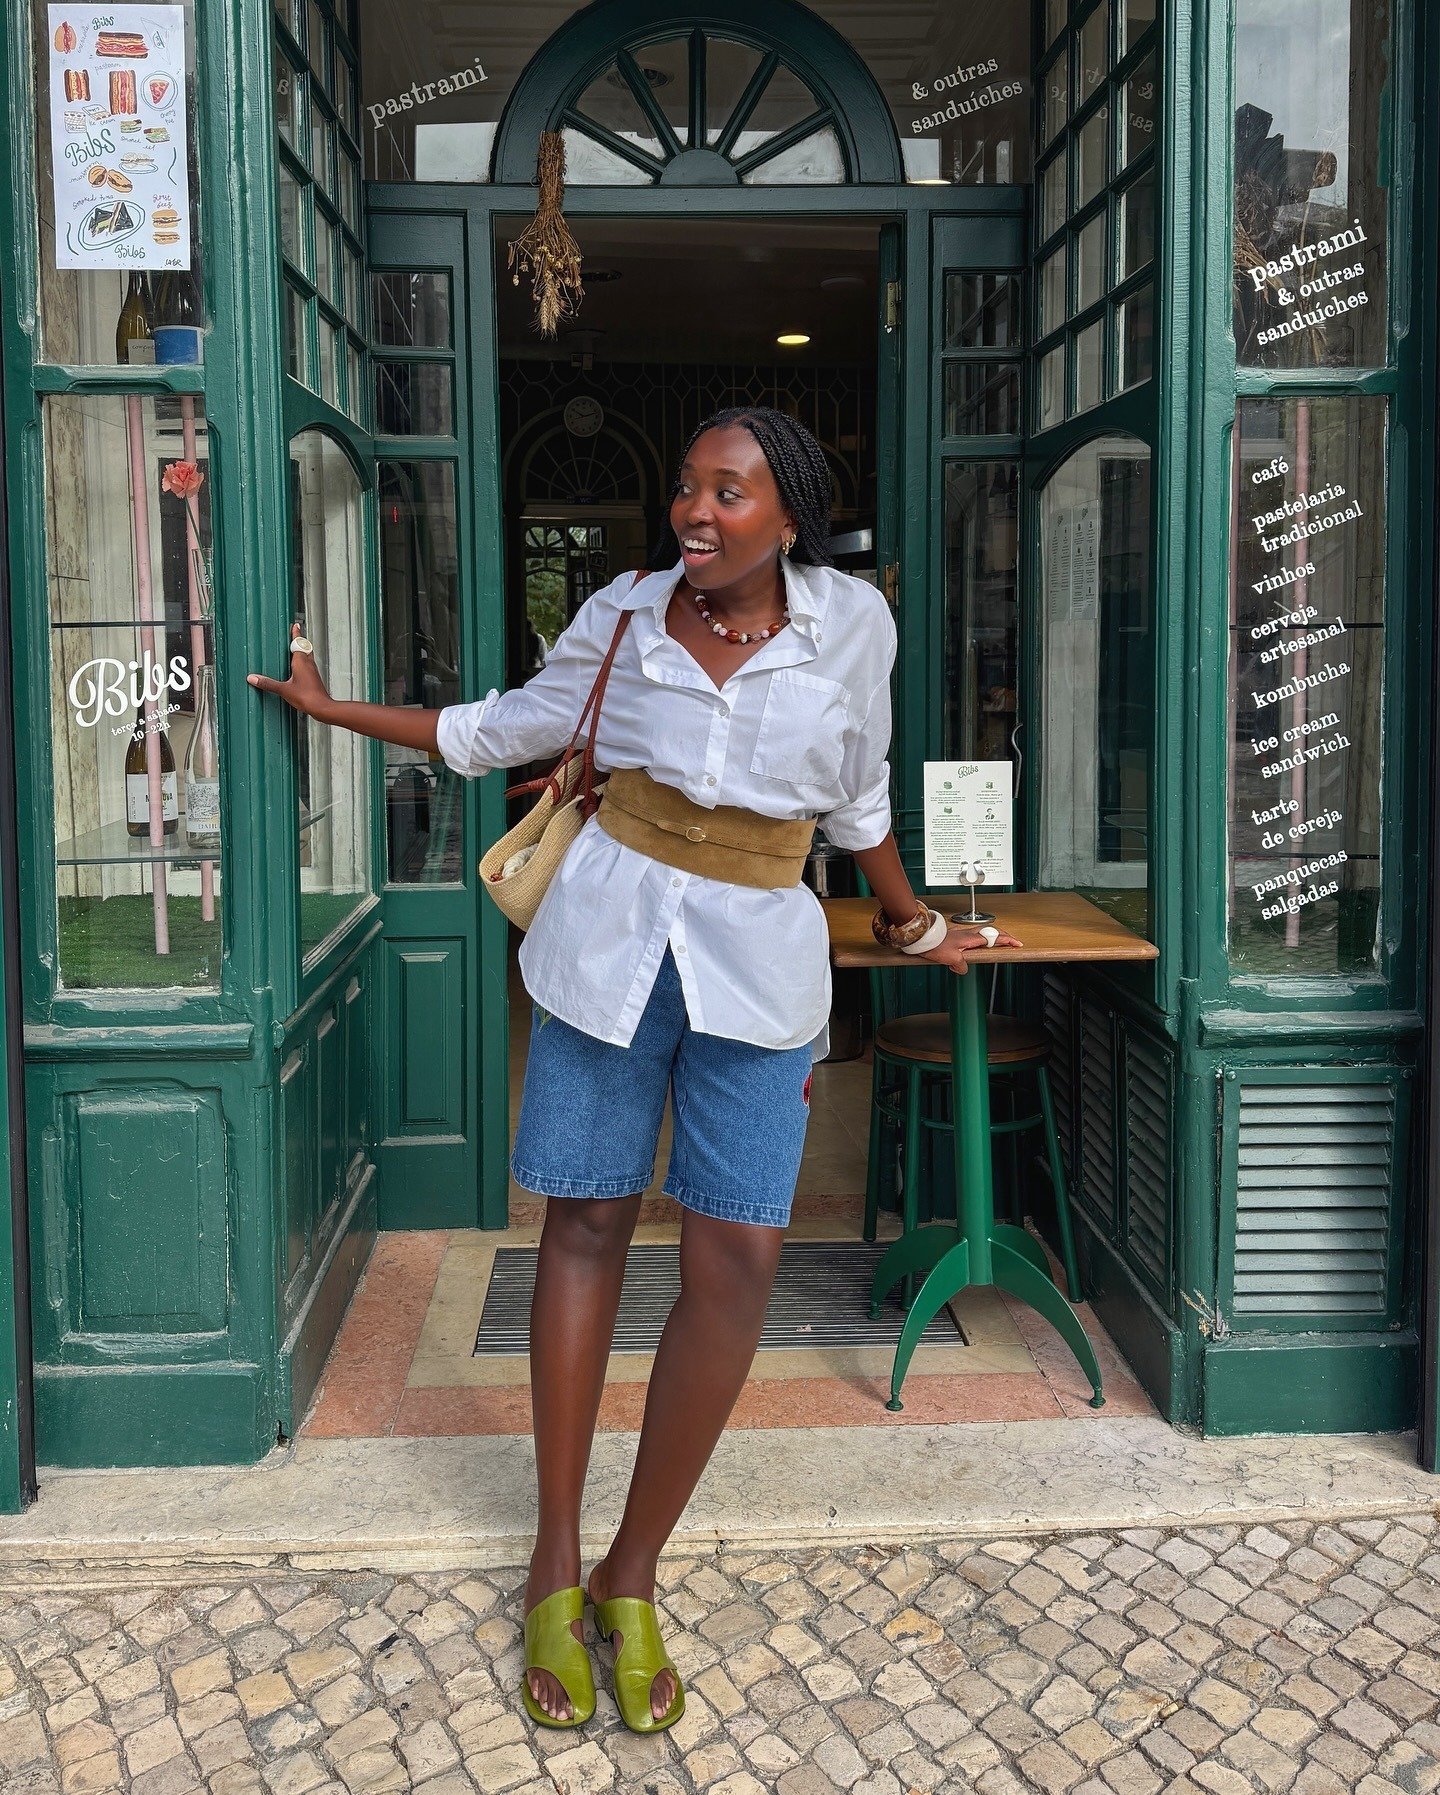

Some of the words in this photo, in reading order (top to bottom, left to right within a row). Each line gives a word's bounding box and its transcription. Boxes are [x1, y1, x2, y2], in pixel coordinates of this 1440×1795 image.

[92, 16, 115, 31] Bibs
[367, 56, 489, 128] pastrami
[912, 81, 929, 101] &
[933, 58, 997, 92] outras
[911, 80, 1024, 134] sanduíches
[65, 128, 116, 167] Bibs
[114, 243, 146, 259] Bibs
[1247, 218, 1368, 292] pastrami
[1277, 288, 1296, 307] &
[1299, 260, 1365, 298] outras
[1256, 288, 1369, 346] sanduíches
[1251, 456, 1289, 484] café
[1251, 482, 1346, 534] pastelaria
[1260, 500, 1364, 553] tradicional
[1251, 561, 1316, 595] vinhos
[1251, 604, 1318, 640] cerveja
[1260, 616, 1348, 664] artesanal
[68, 649, 192, 728] Bibs
[1251, 661, 1351, 709] kombucha
[111, 722, 138, 736] terça
[138, 718, 146, 726] a
[146, 703, 181, 722] sábado
[1251, 738, 1279, 756] ice
[1283, 711, 1340, 742] cream
[957, 764, 979, 779] Bibs
[1261, 732, 1351, 779] sandwich
[1251, 797, 1300, 826] tarte
[1261, 833, 1284, 850] de
[1289, 807, 1343, 840] cereja
[1251, 848, 1348, 901] panquecas
[1261, 879, 1339, 920] salgadas
